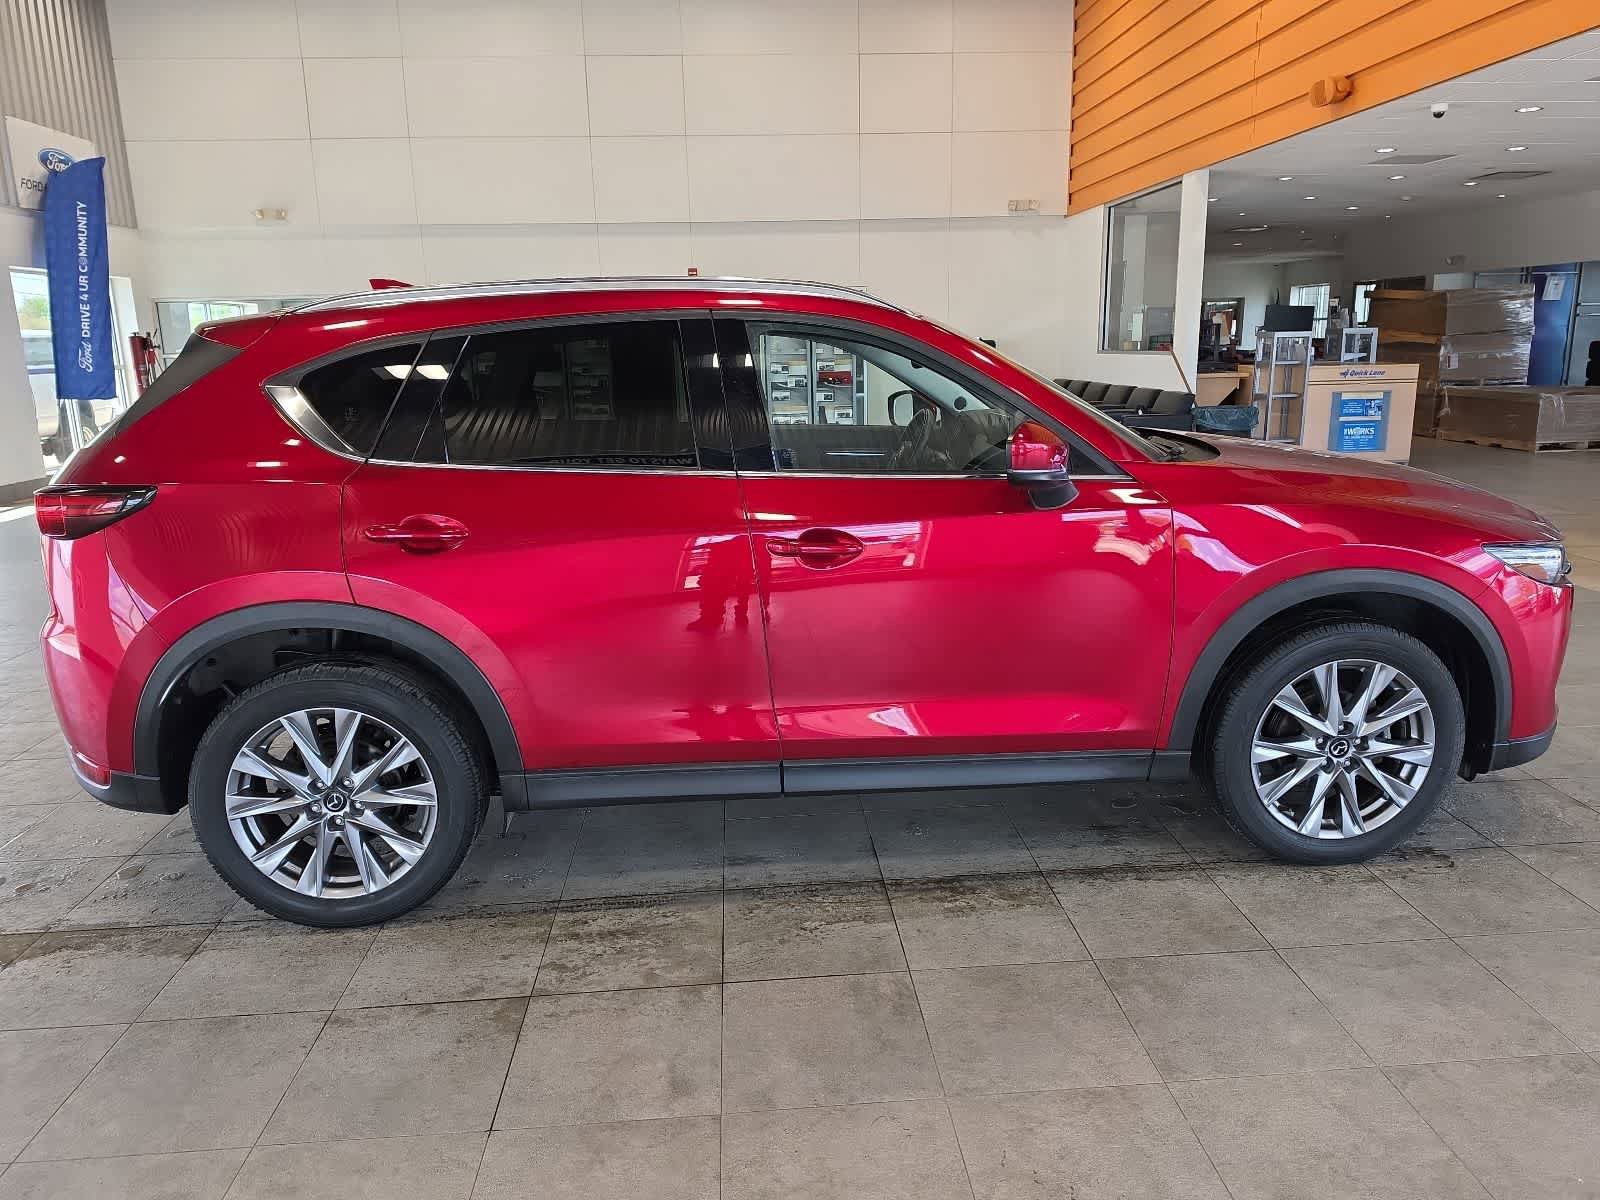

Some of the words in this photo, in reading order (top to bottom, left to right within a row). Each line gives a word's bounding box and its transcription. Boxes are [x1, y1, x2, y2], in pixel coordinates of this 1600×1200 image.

[47, 152, 71, 173] For
[21, 177, 43, 192] FORD
[76, 200, 88, 272] COMMUNITY
[79, 274, 89, 293] UR
[79, 293, 89, 301] 4
[79, 302, 91, 338] DRIVE
[78, 341, 95, 373] Ford
[1349, 369, 1368, 377] Quick
